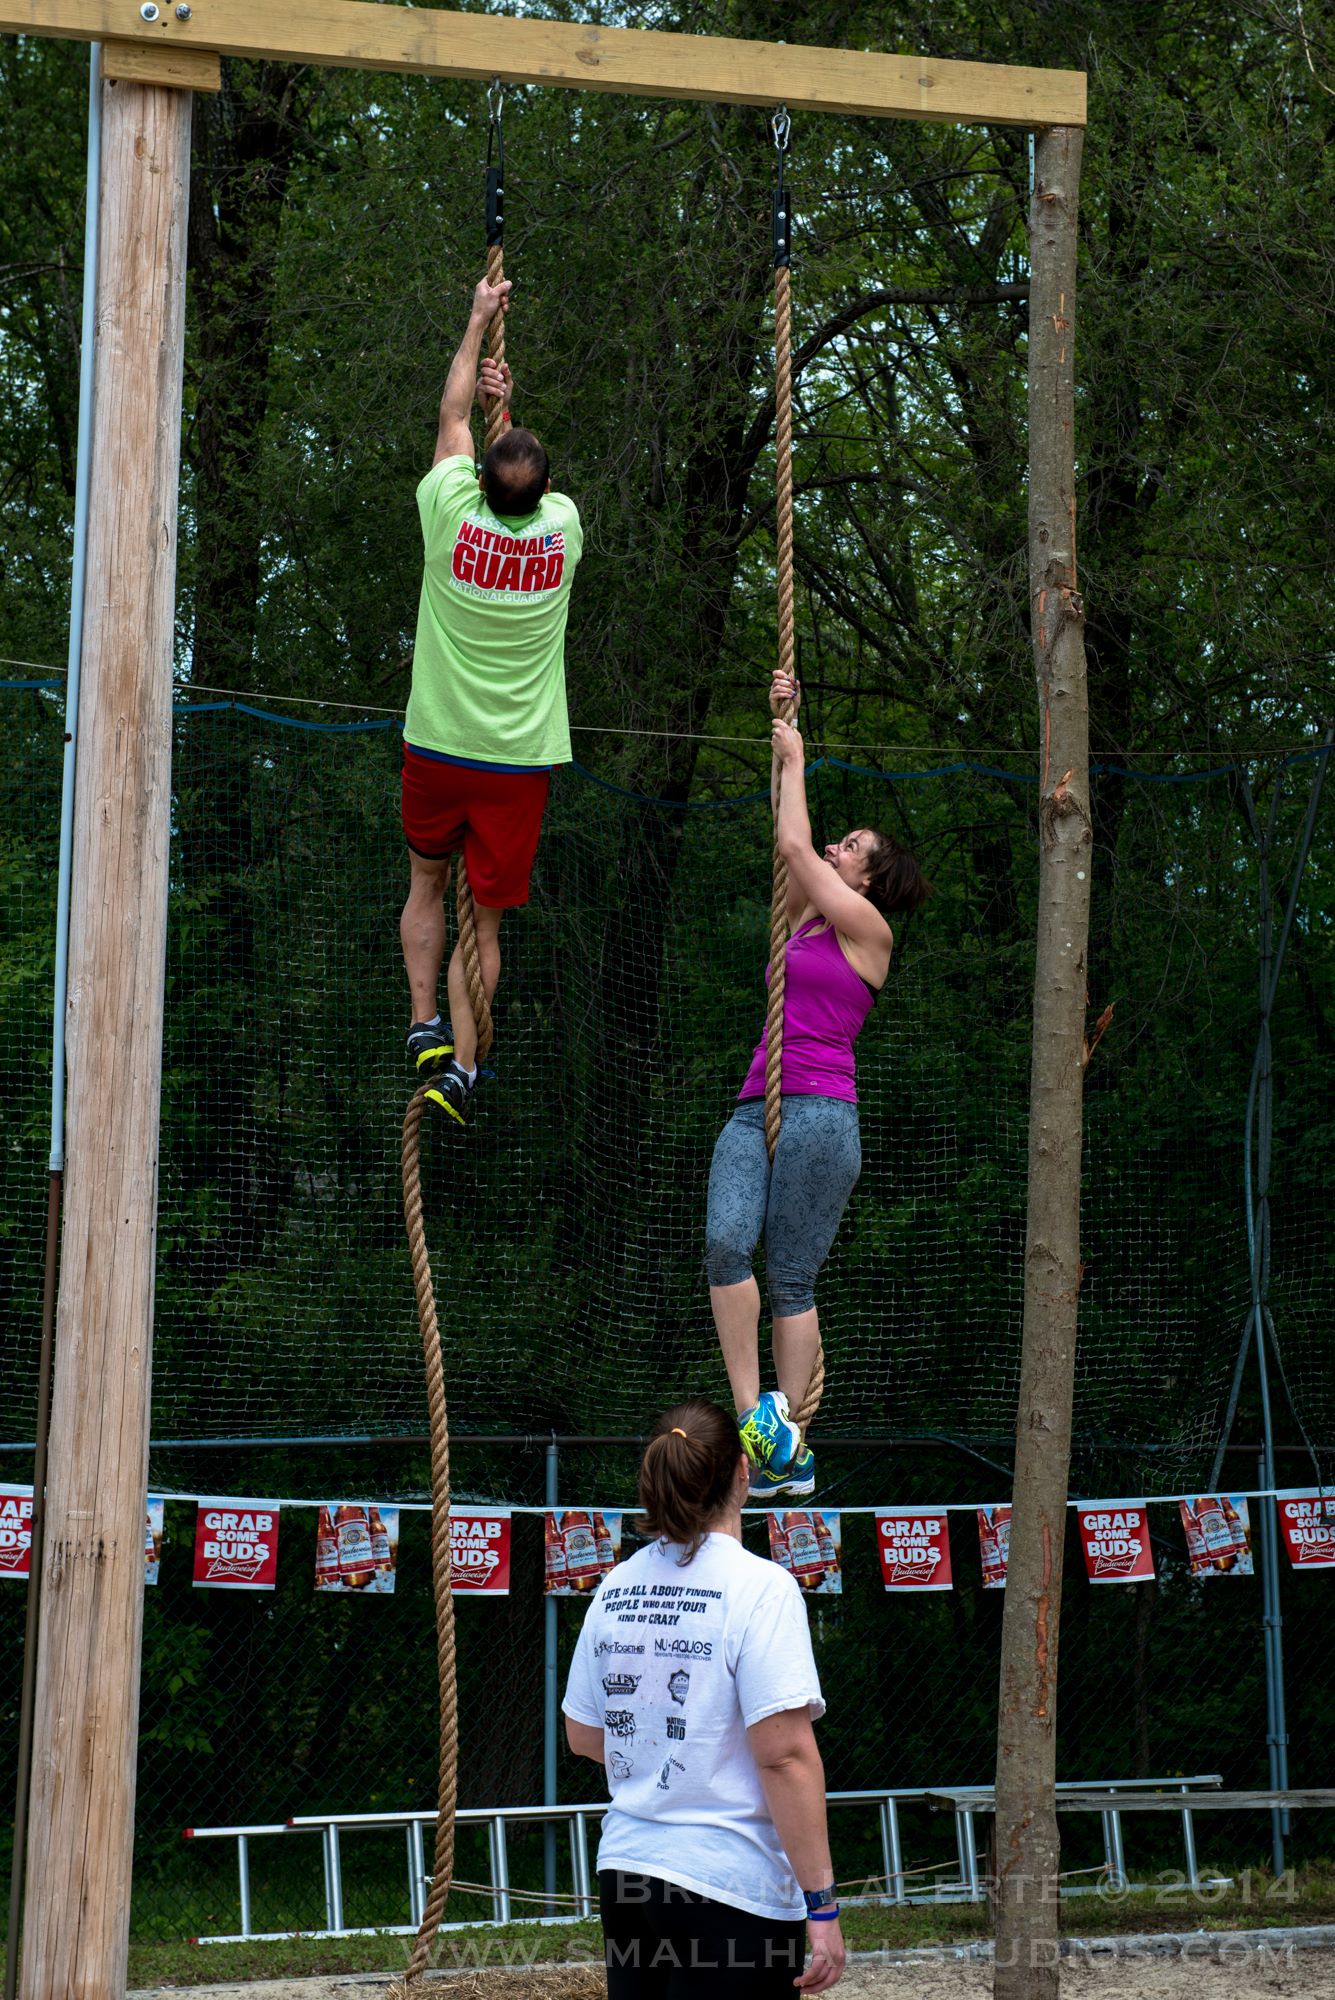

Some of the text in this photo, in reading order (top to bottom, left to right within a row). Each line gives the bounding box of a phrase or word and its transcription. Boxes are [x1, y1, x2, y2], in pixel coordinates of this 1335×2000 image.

[457, 520, 546, 557] NATIONAL
[452, 541, 565, 593] GUARD
[204, 1512, 273, 1532] GRAB
[449, 1520, 502, 1538] RAB
[881, 1520, 941, 1537] GRAB
[1083, 1512, 1141, 1530] GRAB
[216, 1530, 260, 1543] SOME
[892, 1536, 931, 1547] SOME
[1094, 1529, 1131, 1541] SOME
[203, 1541, 270, 1561] BUDS
[884, 1547, 942, 1564] BUDS
[1087, 1539, 1143, 1557] BUDS
[449, 1549, 500, 1567] UDS
[1093, 1559, 1137, 1569] Budweiser
[208, 1561, 261, 1573] Budweiser
[890, 1566, 935, 1576] Budweiser
[601, 1585, 722, 1601] LIFE IS ALL ABOUT FINDING
[604, 1599, 707, 1614] PEOPLE WHO ARE YOUR
[617, 1613, 680, 1626] KIND OF CRAZY
